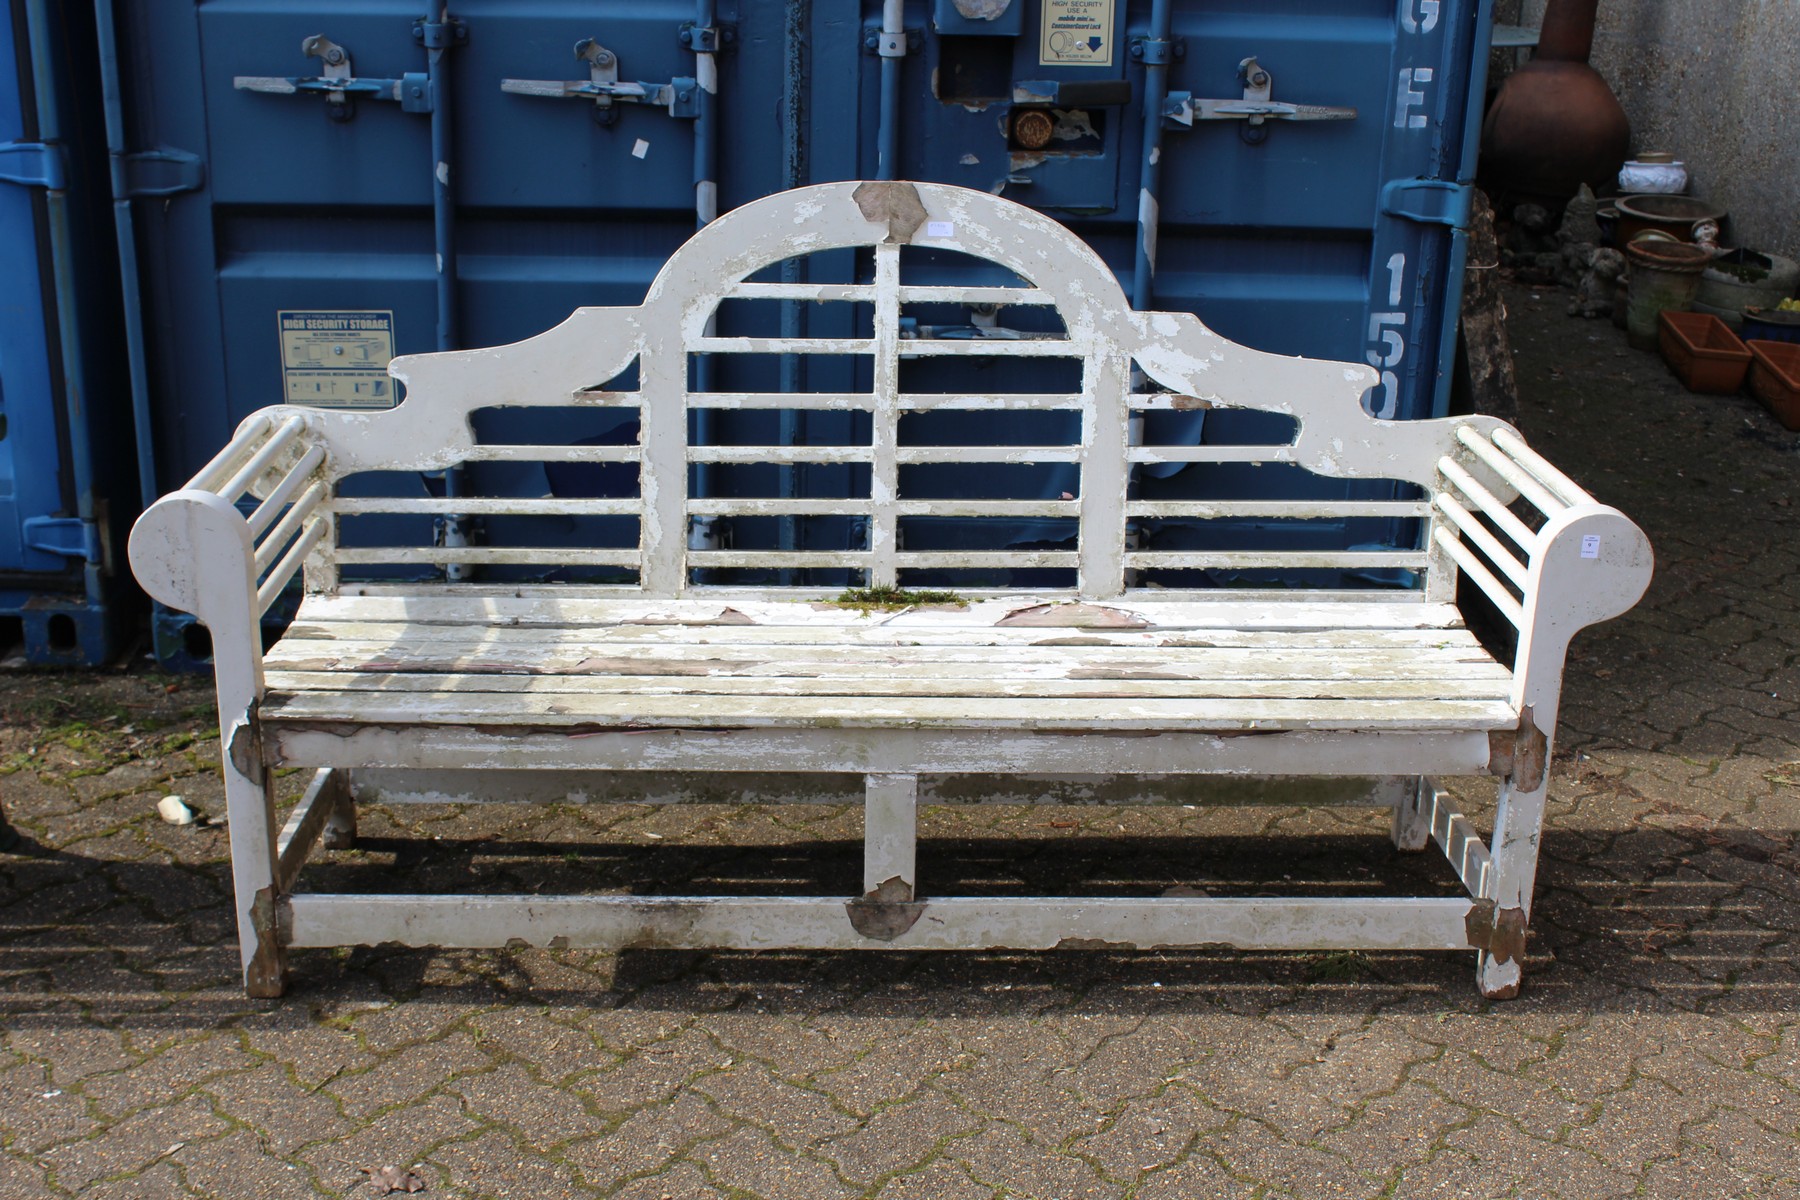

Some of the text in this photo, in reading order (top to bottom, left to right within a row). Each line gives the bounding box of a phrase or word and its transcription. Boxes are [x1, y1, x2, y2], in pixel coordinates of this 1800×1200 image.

[283, 320, 389, 329] HIGH SECURITY STORAGE
